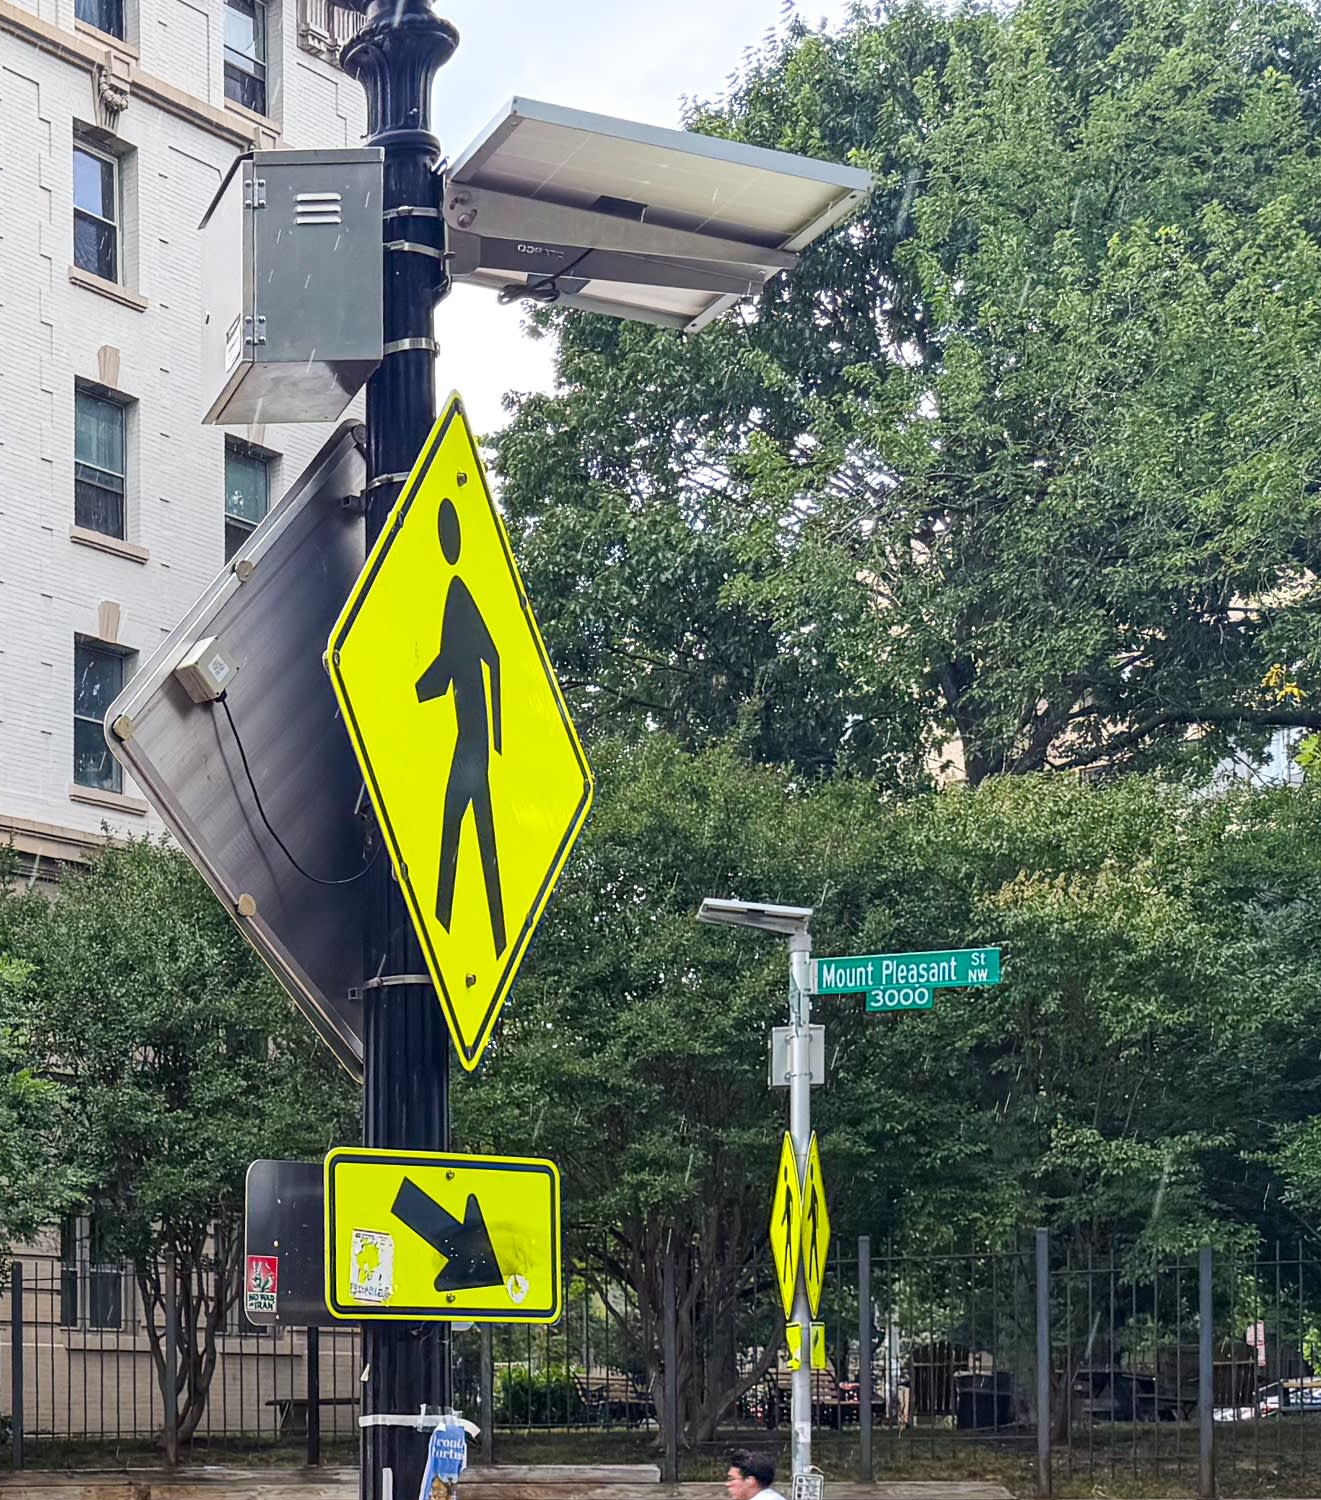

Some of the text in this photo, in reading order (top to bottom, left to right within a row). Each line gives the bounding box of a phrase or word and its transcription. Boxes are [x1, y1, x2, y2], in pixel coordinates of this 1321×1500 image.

[971, 952, 986, 966] St
[822, 956, 958, 989] Mount Pleasant
[968, 969, 988, 983] NW
[870, 988, 929, 1007] 3000
